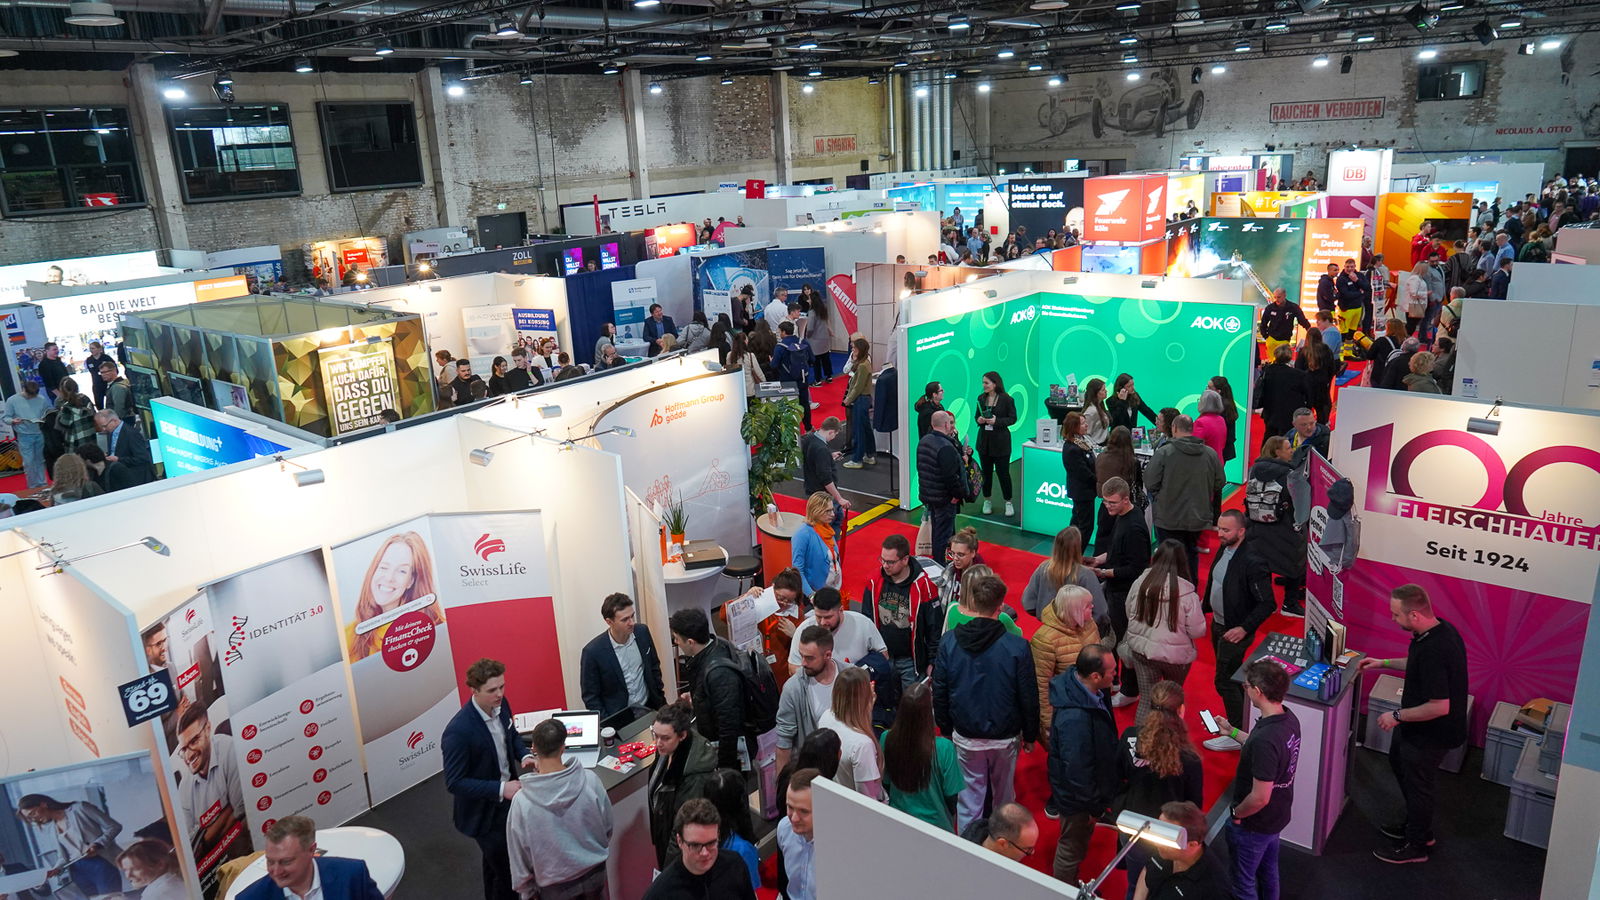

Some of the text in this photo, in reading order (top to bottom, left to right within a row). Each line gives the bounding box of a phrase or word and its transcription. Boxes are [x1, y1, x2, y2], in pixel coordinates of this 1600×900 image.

[1272, 100, 1382, 121] RAUCHEN VERBOTEN
[1495, 127, 1534, 135] NICOLAUS
[1547, 125, 1572, 134] OTTO
[815, 137, 856, 153] NO SMOKING
[1345, 168, 1364, 179] DB
[1012, 184, 1052, 192] Und dann
[1012, 192, 1035, 201] passt
[1048, 191, 1064, 200] auf
[608, 202, 667, 219] TESLA
[1012, 199, 1066, 208] einmal doch.
[1094, 217, 1128, 225] Feuerwehr
[1094, 224, 1109, 232] Köln
[1320, 240, 1345, 248] Deine
[512, 250, 532, 261] ZOLL
[1313, 248, 1358, 259] Ausbildung
[80, 296, 157, 315] BAU DIE WELT
[1009, 309, 1028, 325] AOK
[1190, 315, 1224, 330] AOK
[330, 356, 386, 374] WIR KÄMPFEN
[332, 373, 356, 386] AUCH
[333, 376, 391, 403] DASS DU
[336, 392, 393, 424] GEGEN
[665, 393, 725, 414] Hoffmann Group
[665, 410, 687, 424] gödde
[339, 423, 354, 432] UNS
[354, 419, 369, 429] SEIN
[1351, 422, 1600, 518] 100
[1036, 496, 1074, 509] Die Gesundheits
[1539, 509, 1583, 528] Jahre
[1425, 540, 1530, 573] Seit 1924
[460, 561, 527, 578] SwissLife
[461, 578, 489, 588] Select
[249, 604, 324, 640] IDENTITÄT 3.0
[404, 619, 422, 629] deinem
[384, 622, 433, 646] FinanzCheck
[387, 641, 407, 653] checken
[414, 634, 430, 645] sparen
[128, 682, 169, 713] 69
[398, 741, 436, 767] SwissLife
[197, 845, 223, 874] estimmt
